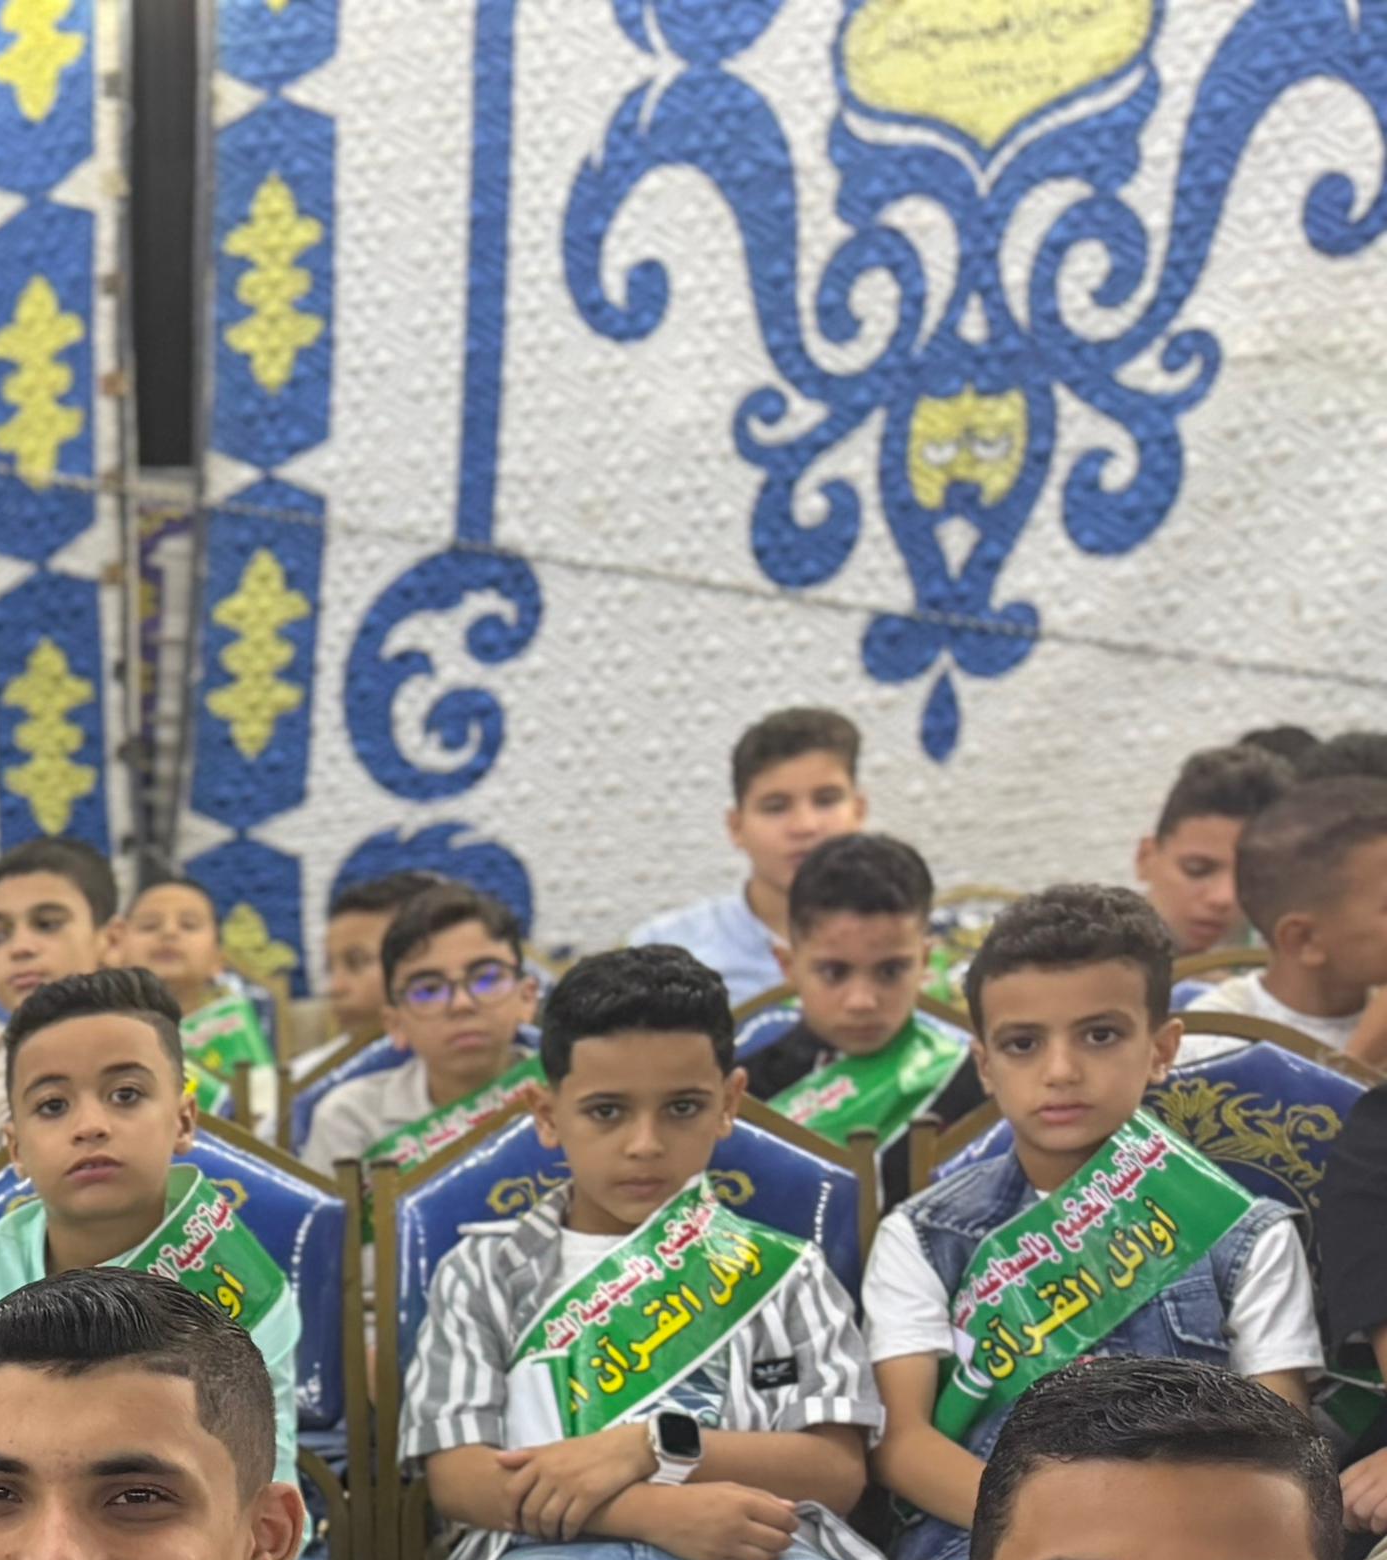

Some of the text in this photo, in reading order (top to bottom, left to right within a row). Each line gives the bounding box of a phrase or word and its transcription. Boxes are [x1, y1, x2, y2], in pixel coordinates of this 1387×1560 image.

[1109, 1197, 1178, 1288] أوائل
[590, 1283, 704, 1394] القرآن
[982, 1266, 1103, 1379] القرآن
